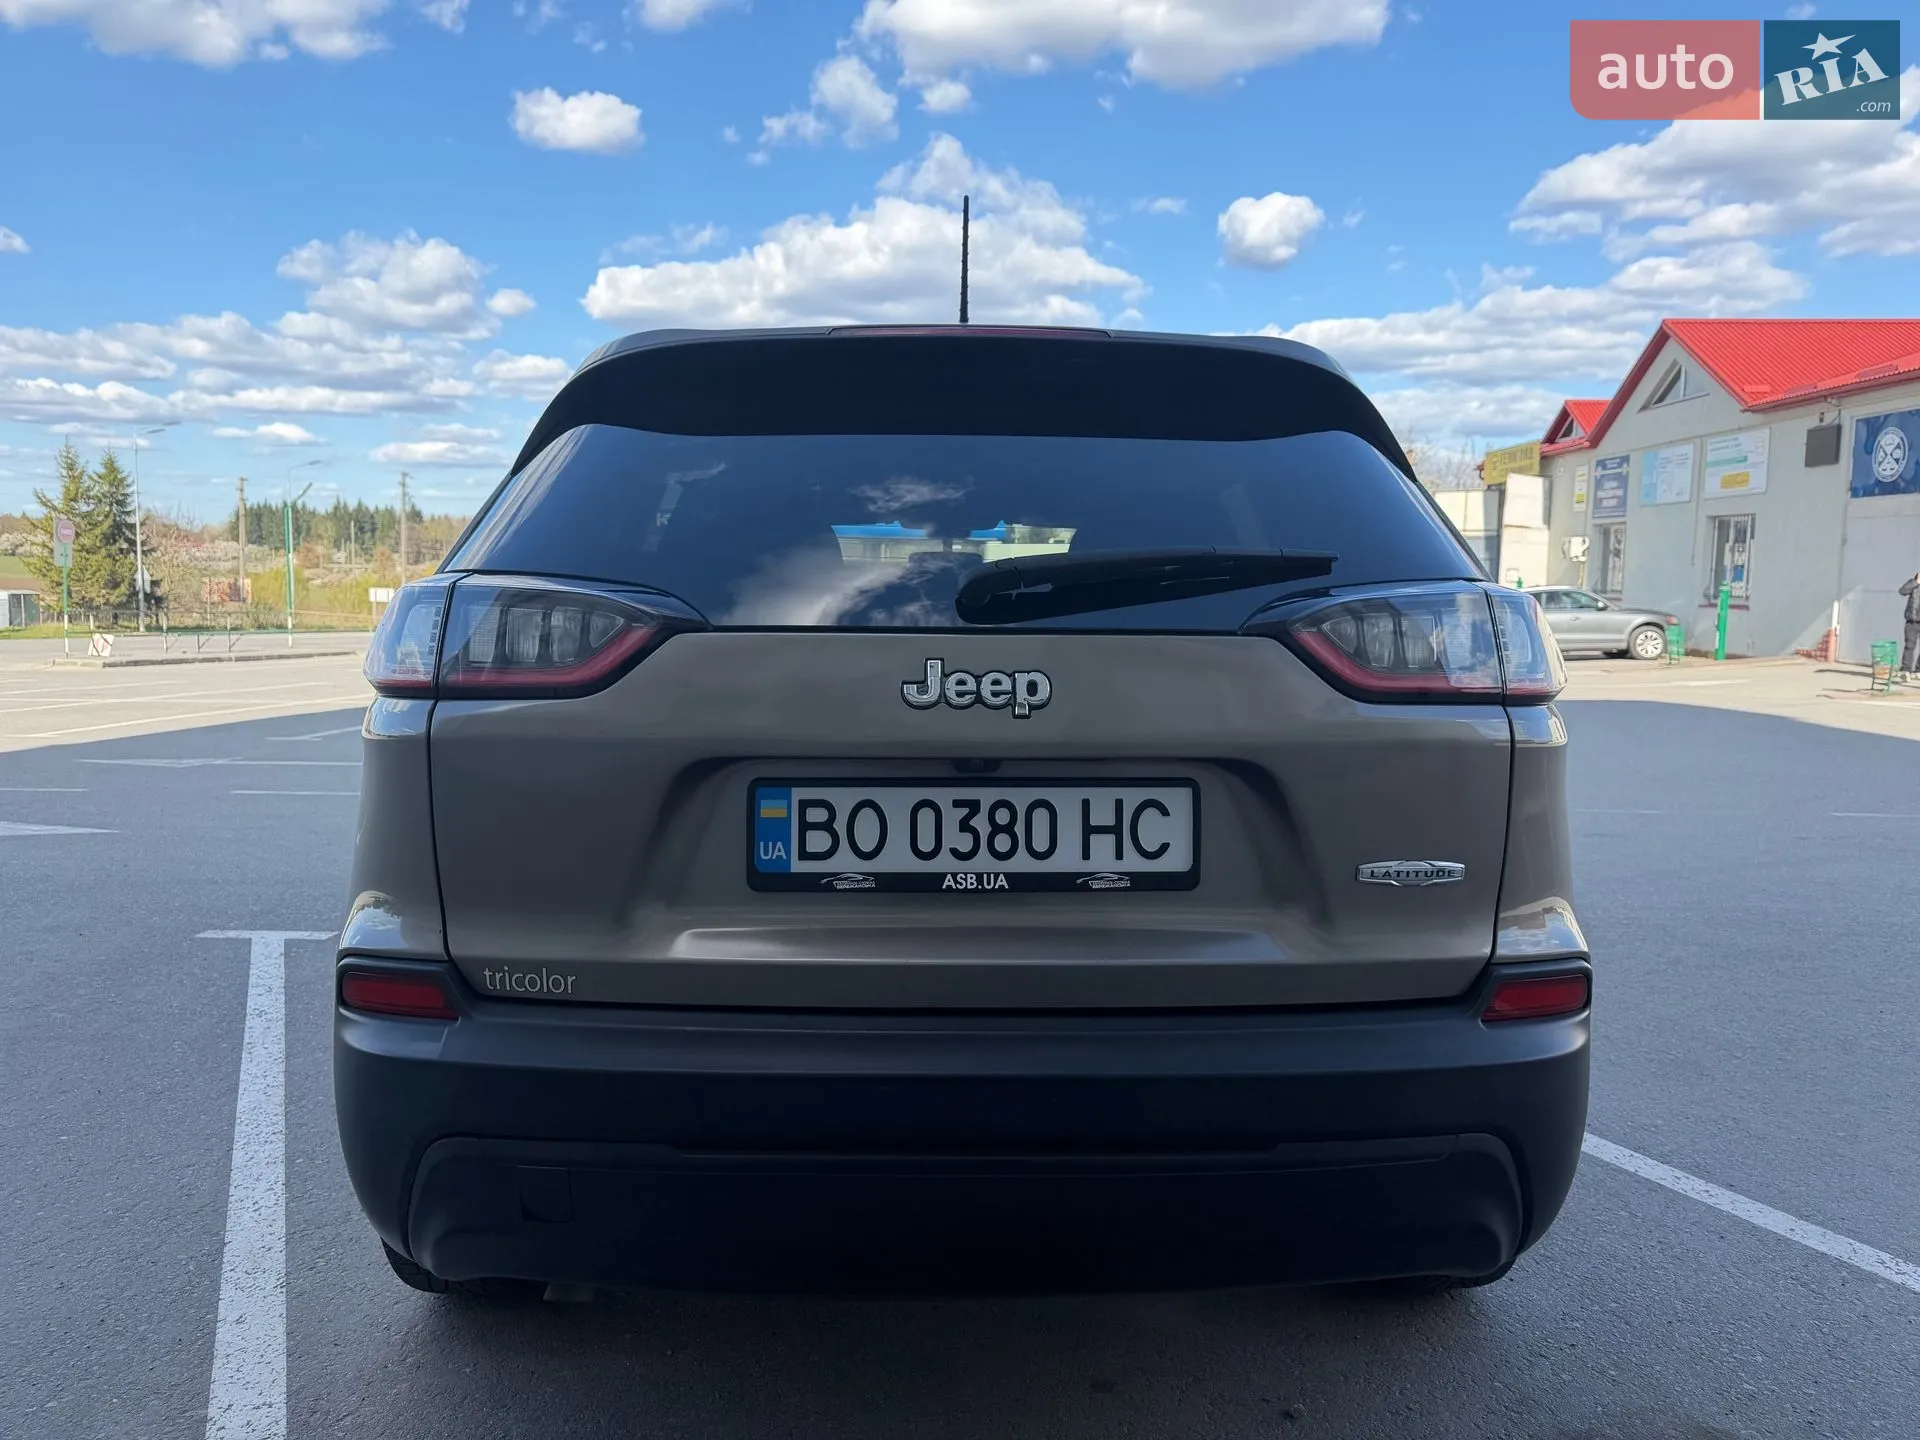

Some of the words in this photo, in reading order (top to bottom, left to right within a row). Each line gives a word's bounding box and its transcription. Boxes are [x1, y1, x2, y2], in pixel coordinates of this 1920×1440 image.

[901, 658, 1052, 719] Jeep
[798, 799, 888, 861] BO
[909, 799, 1058, 861] 0380
[1081, 798, 1171, 861] HC
[759, 841, 787, 860] UA
[942, 873, 1009, 889] ASB.UA
[1370, 869, 1457, 878] LATITUDE
[483, 965, 576, 994] tricolor
